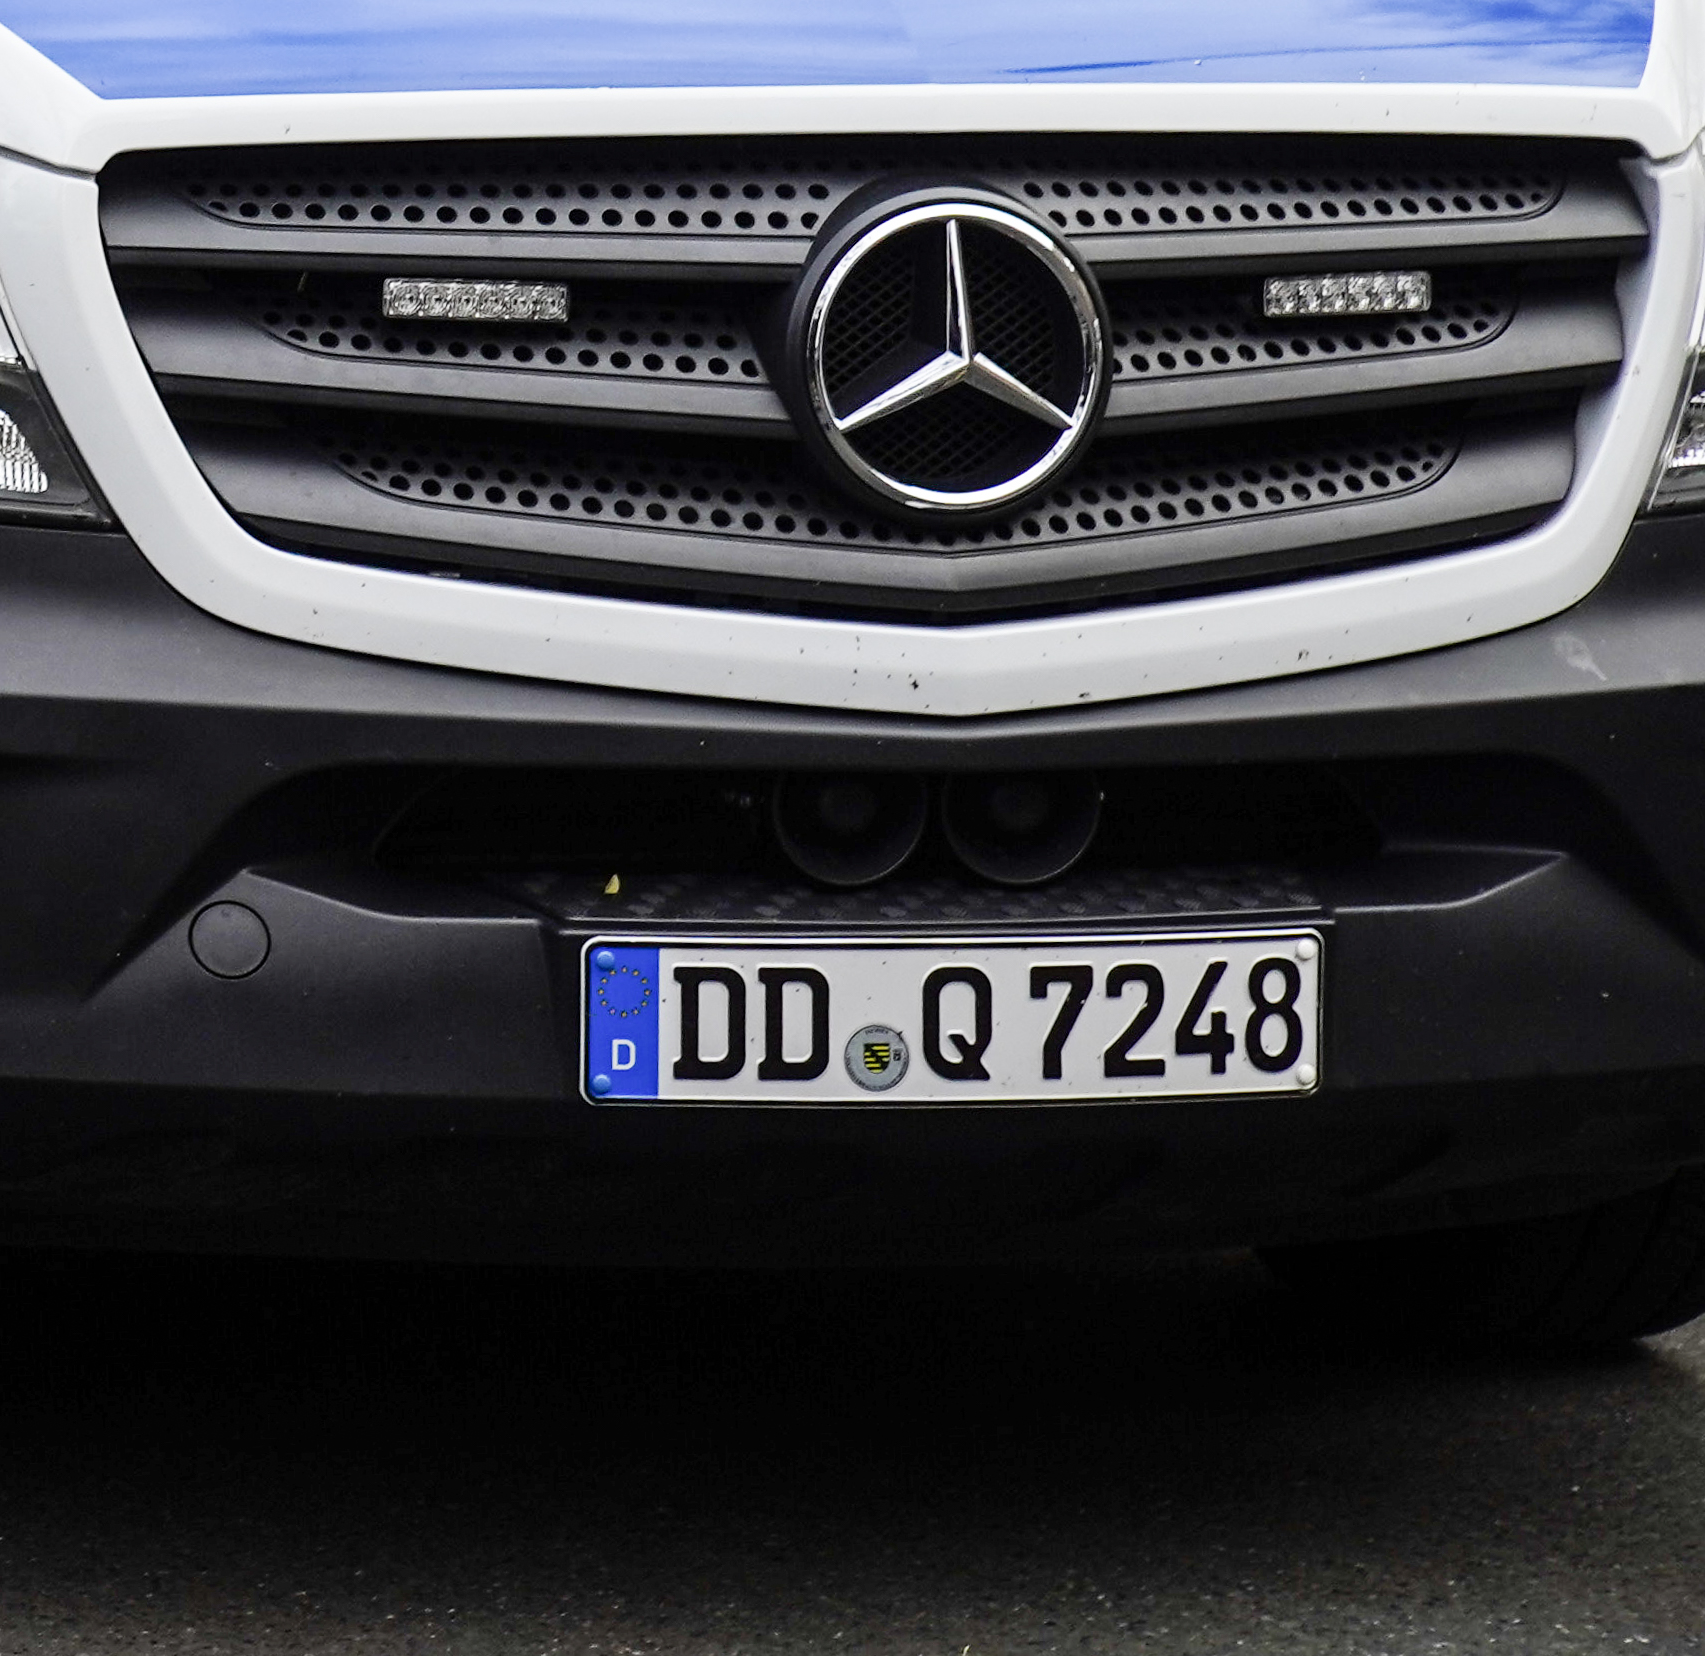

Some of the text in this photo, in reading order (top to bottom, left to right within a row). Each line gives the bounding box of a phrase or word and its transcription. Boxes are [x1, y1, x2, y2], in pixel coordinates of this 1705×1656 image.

[611, 1038, 637, 1071] D
[673, 957, 1304, 1082] DD Q 7248
